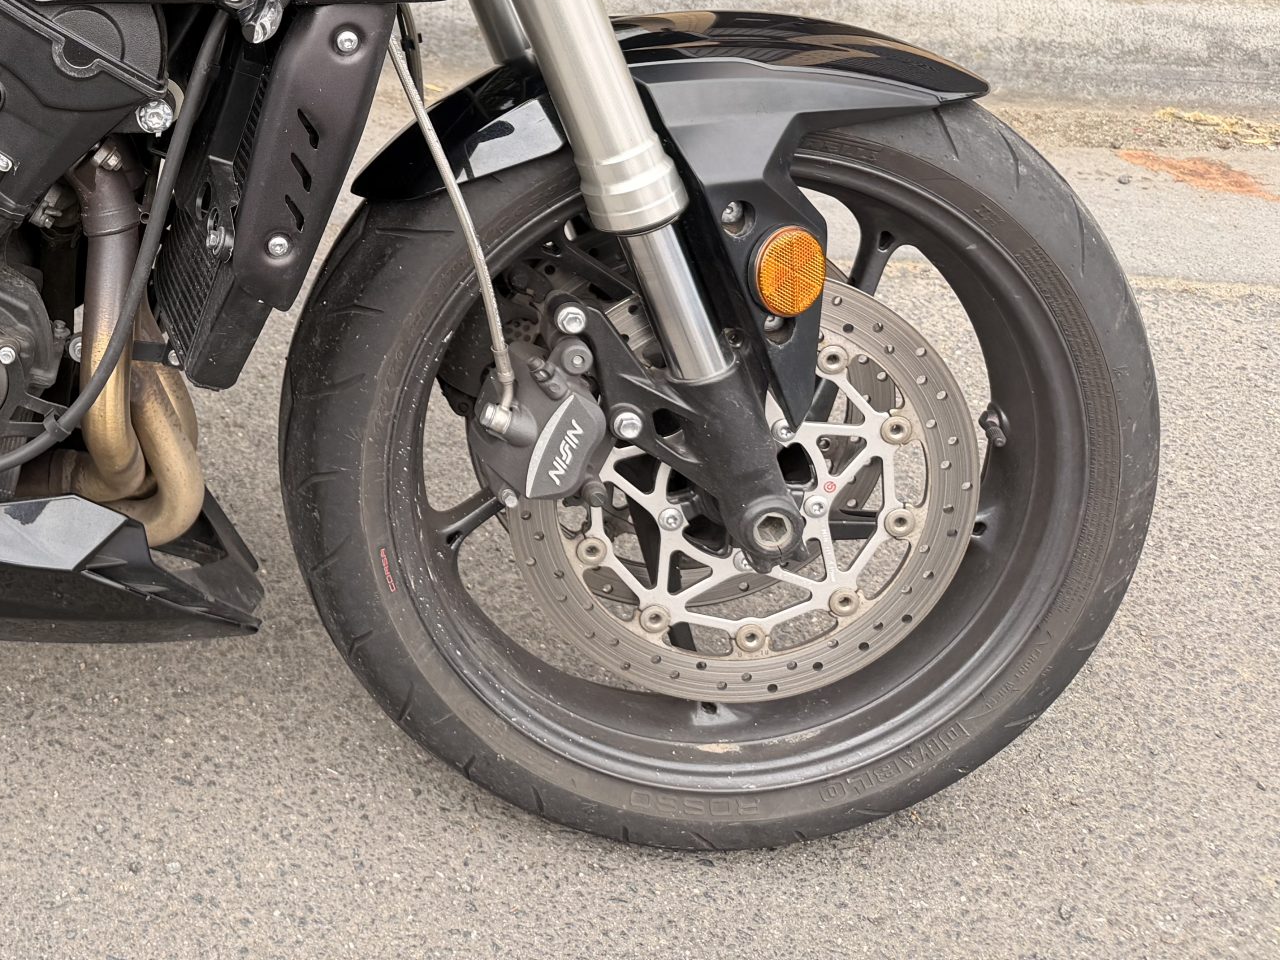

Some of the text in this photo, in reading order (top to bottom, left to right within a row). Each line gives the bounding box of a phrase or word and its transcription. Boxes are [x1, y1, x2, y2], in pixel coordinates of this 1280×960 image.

[380, 547, 397, 593] CORSA
[629, 720, 971, 818] DIABLO ROSSO
